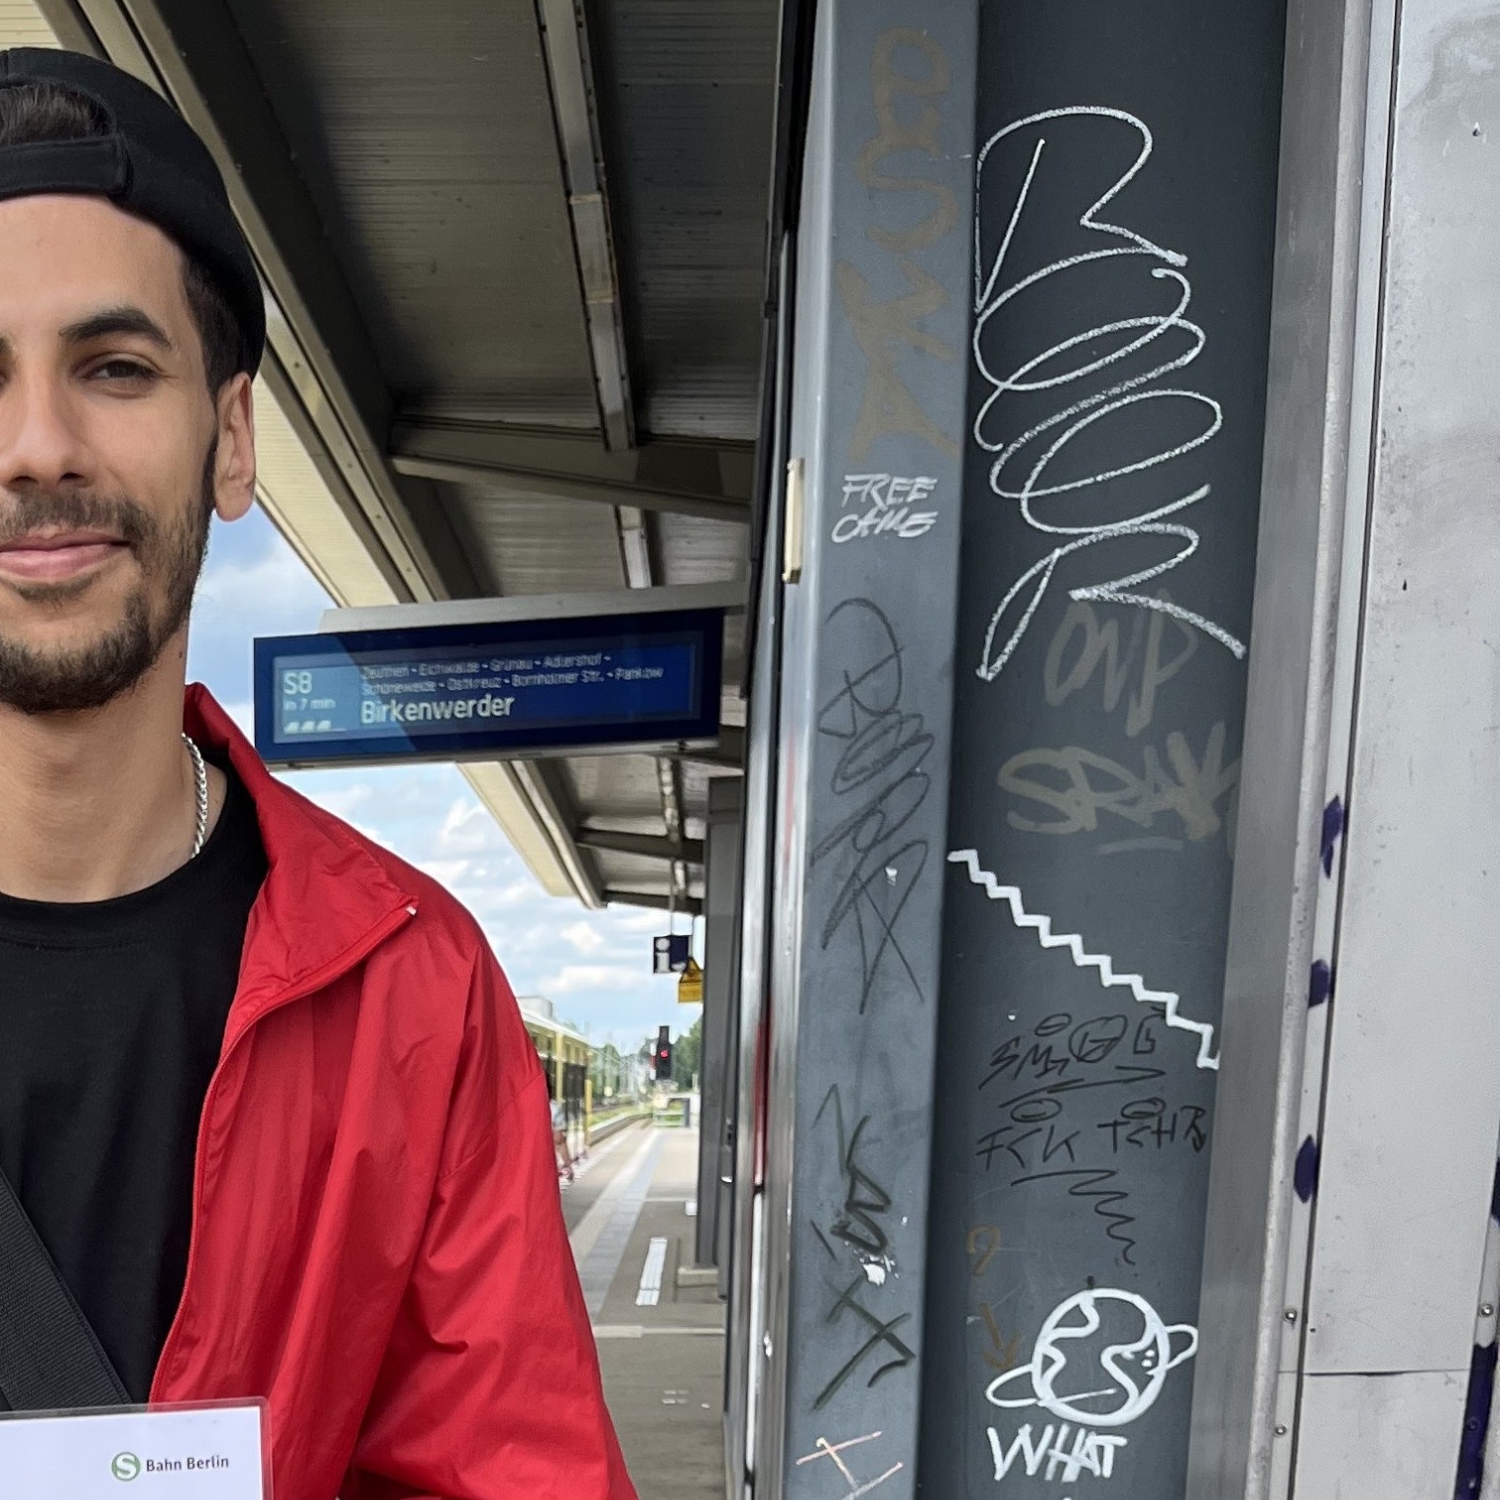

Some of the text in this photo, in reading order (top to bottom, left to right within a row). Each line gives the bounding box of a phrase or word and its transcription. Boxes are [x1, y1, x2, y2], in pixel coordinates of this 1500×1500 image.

[842, 473, 938, 512] FREE
[283, 671, 313, 695] S8
[300, 698, 309, 711] 7
[360, 693, 516, 724] Birkenwerder
[146, 1458, 182, 1472] Bahn
[187, 1454, 229, 1470] Berlin
[987, 1423, 1129, 1483] WHAT
